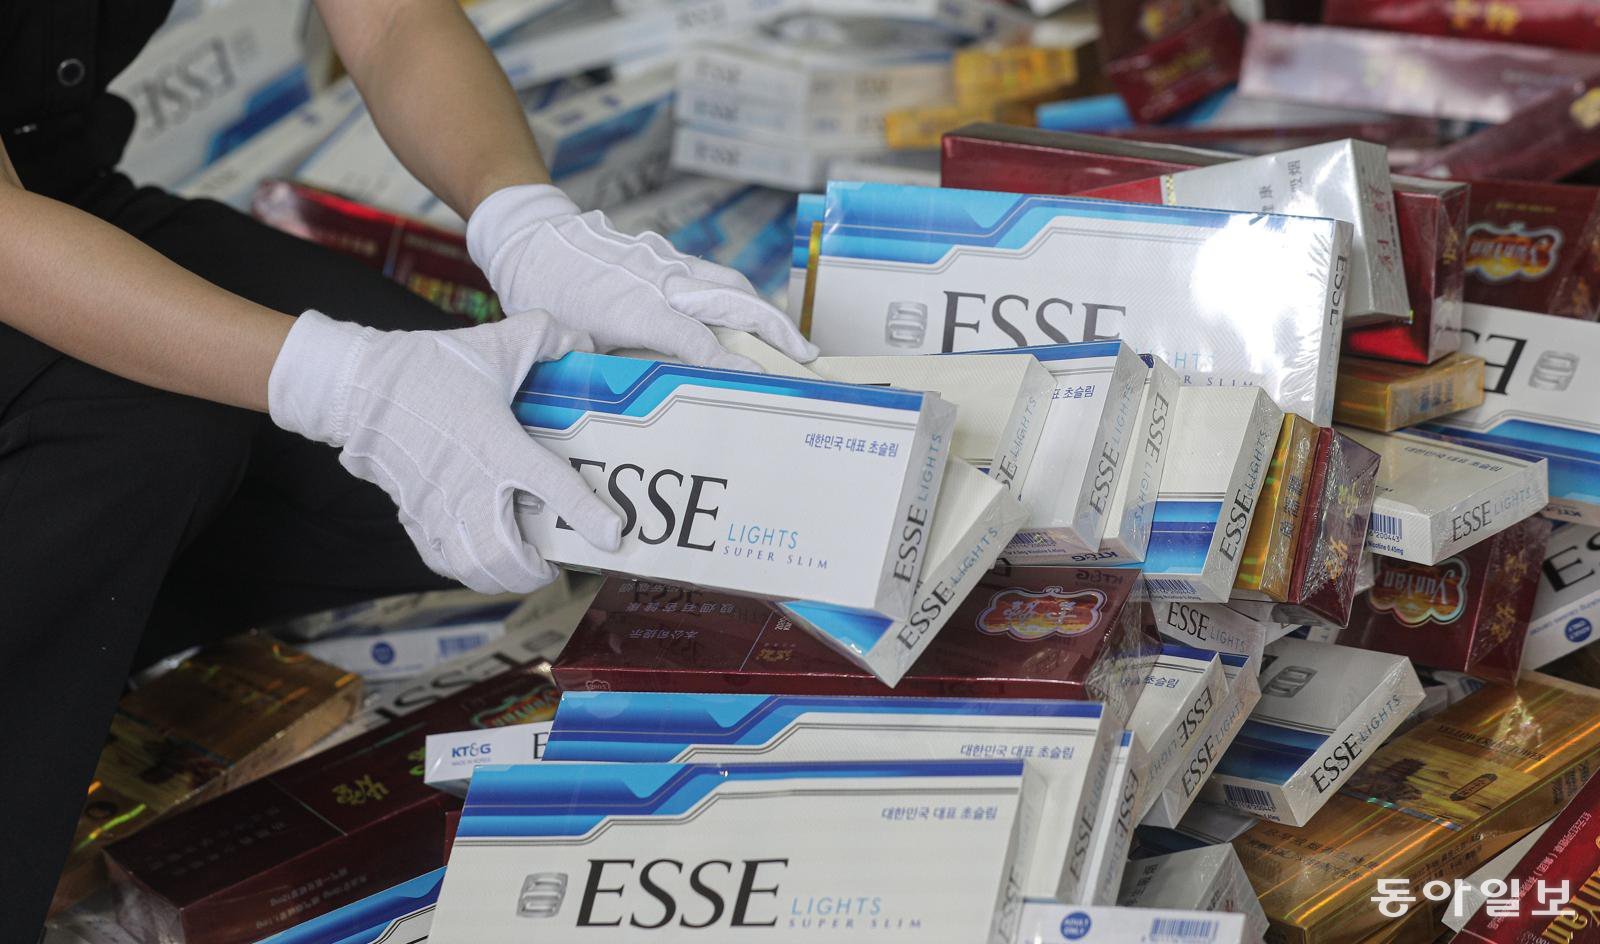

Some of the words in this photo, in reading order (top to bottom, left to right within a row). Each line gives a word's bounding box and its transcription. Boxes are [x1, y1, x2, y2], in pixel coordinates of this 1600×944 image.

[1064, 385, 1095, 399] 초슬림
[805, 433, 843, 451] 대한민국
[845, 437, 865, 453] 대표
[868, 441, 898, 457] 초슬림
[1145, 391, 1169, 463] ESSE
[1089, 442, 1120, 515] ESSE
[894, 505, 928, 582] ESSE
[918, 432, 942, 501] LIGHTS
[1219, 489, 1254, 562] ESSE
[1451, 500, 1492, 543] ESSE
[724, 545, 775, 562] SUPER
[787, 556, 828, 569] SLIM
[728, 524, 797, 549] LIGHTS
[896, 581, 955, 651] ESSE
[951, 527, 999, 588] LIGHTS
[1167, 602, 1209, 641] ESSE
[1176, 686, 1214, 748] ESSE
[452, 742, 491, 758] KT&G
[960, 743, 1006, 758] 대한민국
[1011, 744, 1034, 758] 대표
[1310, 733, 1363, 794] ESSE
[1358, 694, 1401, 744] LIGHTS
[1181, 735, 1217, 799] ESSE
[881, 805, 930, 821] 대한민국
[933, 806, 957, 820] 대표
[576, 858, 789, 929] ESSE
[791, 897, 882, 917] LIGHTS
[788, 918, 855, 929] SUPER
[871, 918, 922, 929] SLIM
